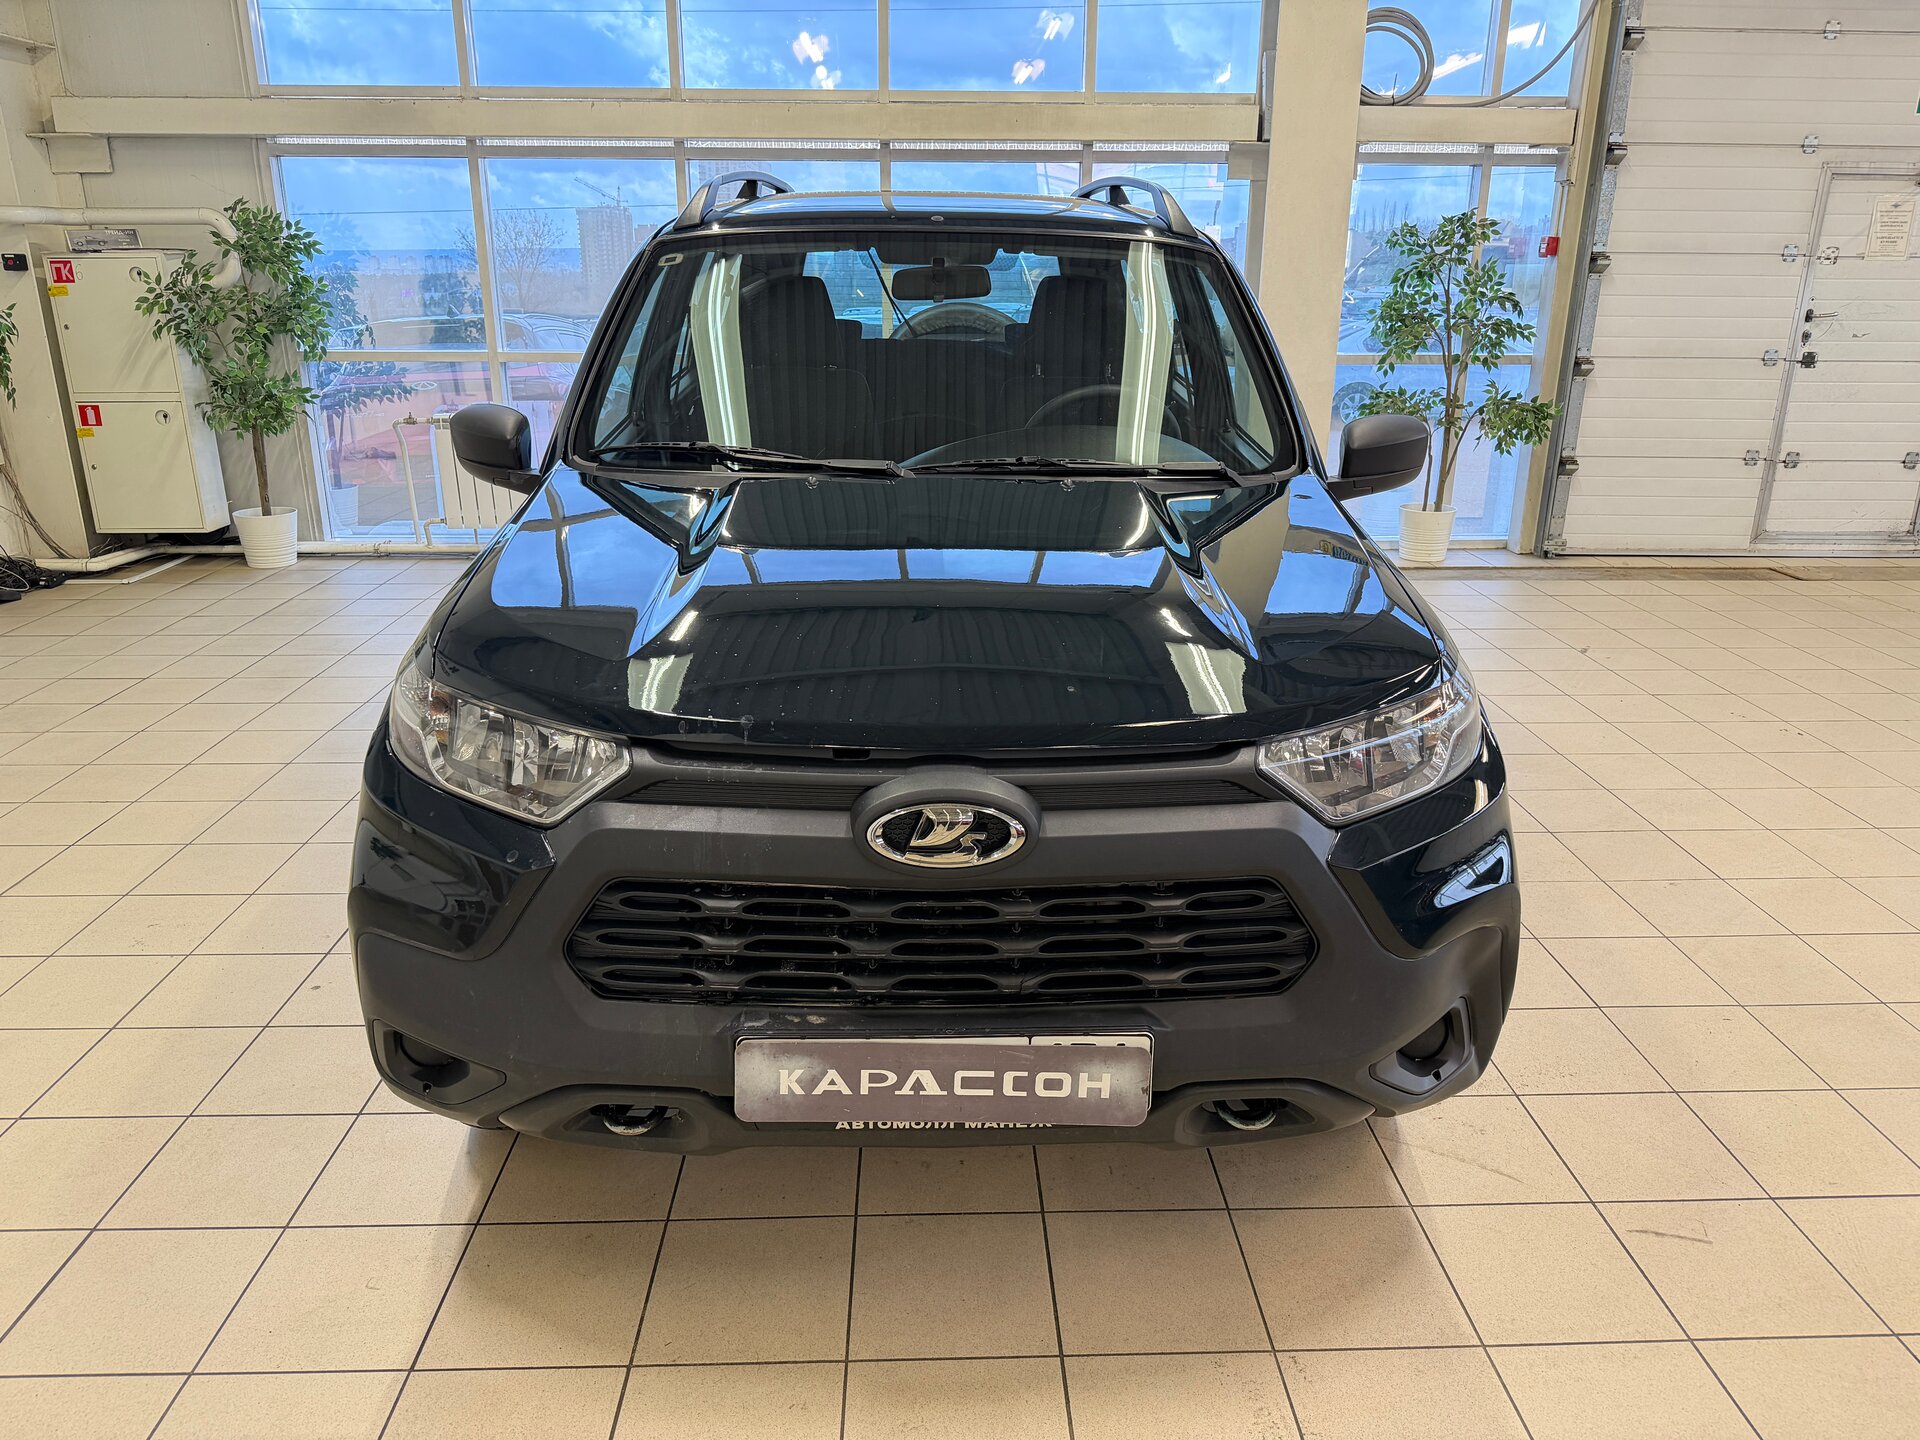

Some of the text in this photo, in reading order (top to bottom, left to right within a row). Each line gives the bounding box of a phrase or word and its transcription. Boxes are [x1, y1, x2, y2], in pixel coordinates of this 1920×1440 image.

[51, 263, 74, 281] ПК
[75, 263, 83, 280] 6
[778, 1069, 1111, 1099] КАРАССОН
[835, 1120, 955, 1130] АВТОМОЛЛ
